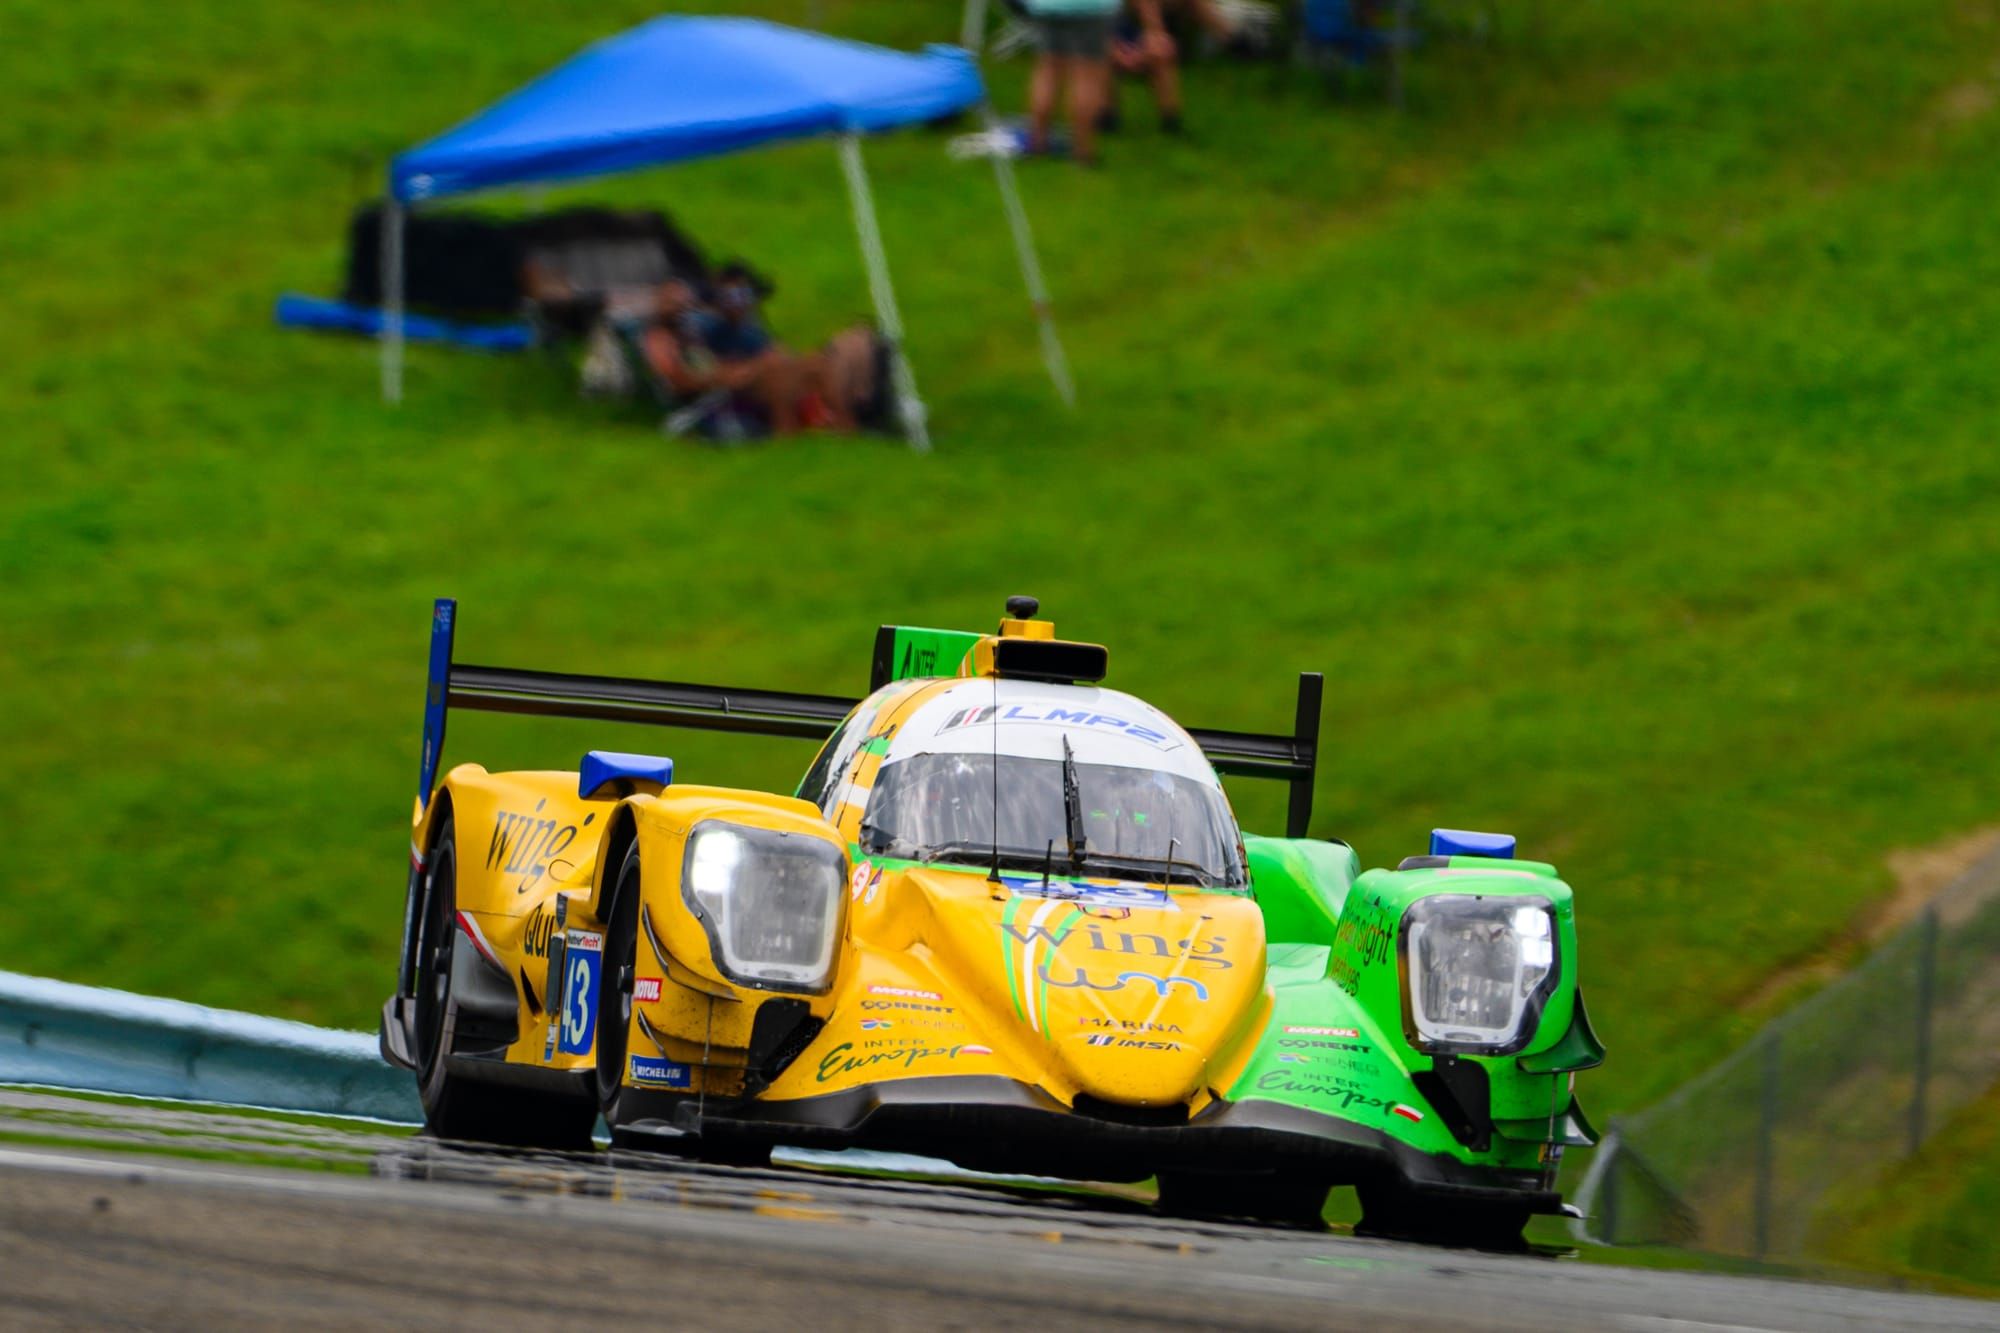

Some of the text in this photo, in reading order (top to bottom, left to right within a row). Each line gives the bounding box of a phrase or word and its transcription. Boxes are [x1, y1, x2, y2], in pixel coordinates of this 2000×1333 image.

[1004, 706, 1168, 744] LMP2
[994, 922, 1234, 970] wing
[562, 956, 591, 1046] 43
[871, 987, 938, 1000] MOTUL
[864, 1040, 925, 1048] INTER
[1117, 1039, 1182, 1052] IMSA
[636, 1064, 681, 1079] MICHELIN
[1303, 1072, 1362, 1090] INTER
